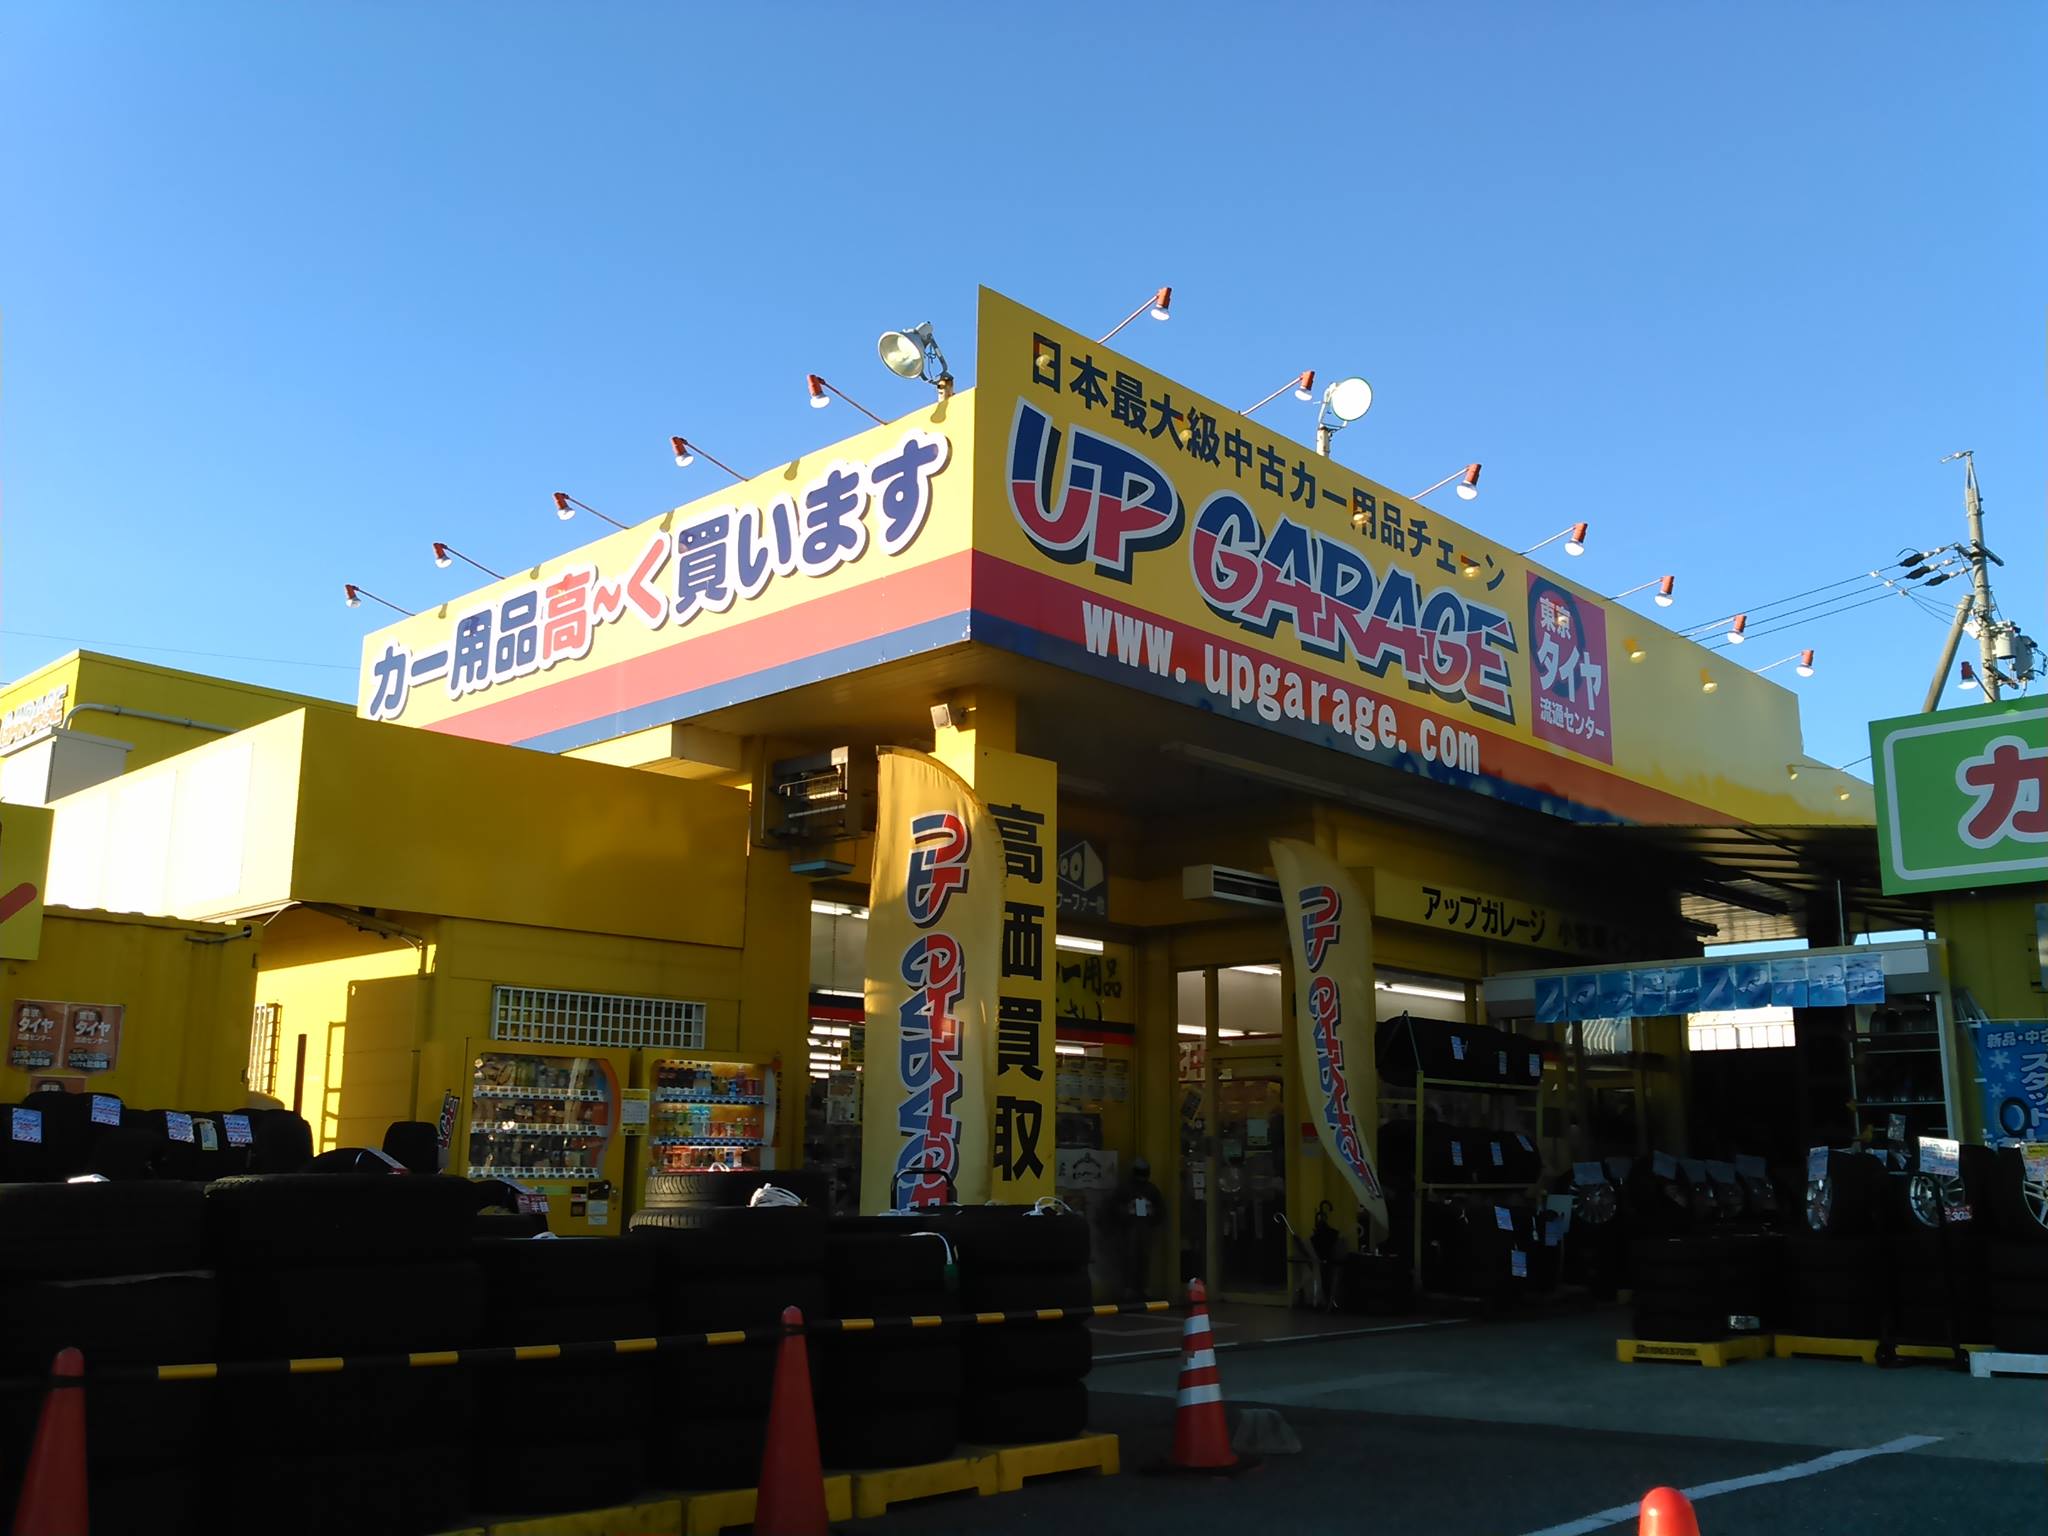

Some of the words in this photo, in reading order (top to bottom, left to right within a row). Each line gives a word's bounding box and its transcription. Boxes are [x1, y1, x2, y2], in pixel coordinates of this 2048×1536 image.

[1033, 332, 1504, 591] 日本最大級中古カー用品チェーン
[1005, 394, 1186, 583] UP
[1189, 488, 1519, 725] GARAGE
[1540, 597, 1571, 640] 東京
[1537, 631, 1602, 711] タイヤ
[1540, 697, 1605, 740] 流通センター
[906, 810, 971, 929] UP
[1299, 886, 1341, 973] UP
[1422, 886, 1546, 942] アップガレージ
[18, 1017, 55, 1034] タイヤ
[75, 1021, 112, 1037] タイヤ
